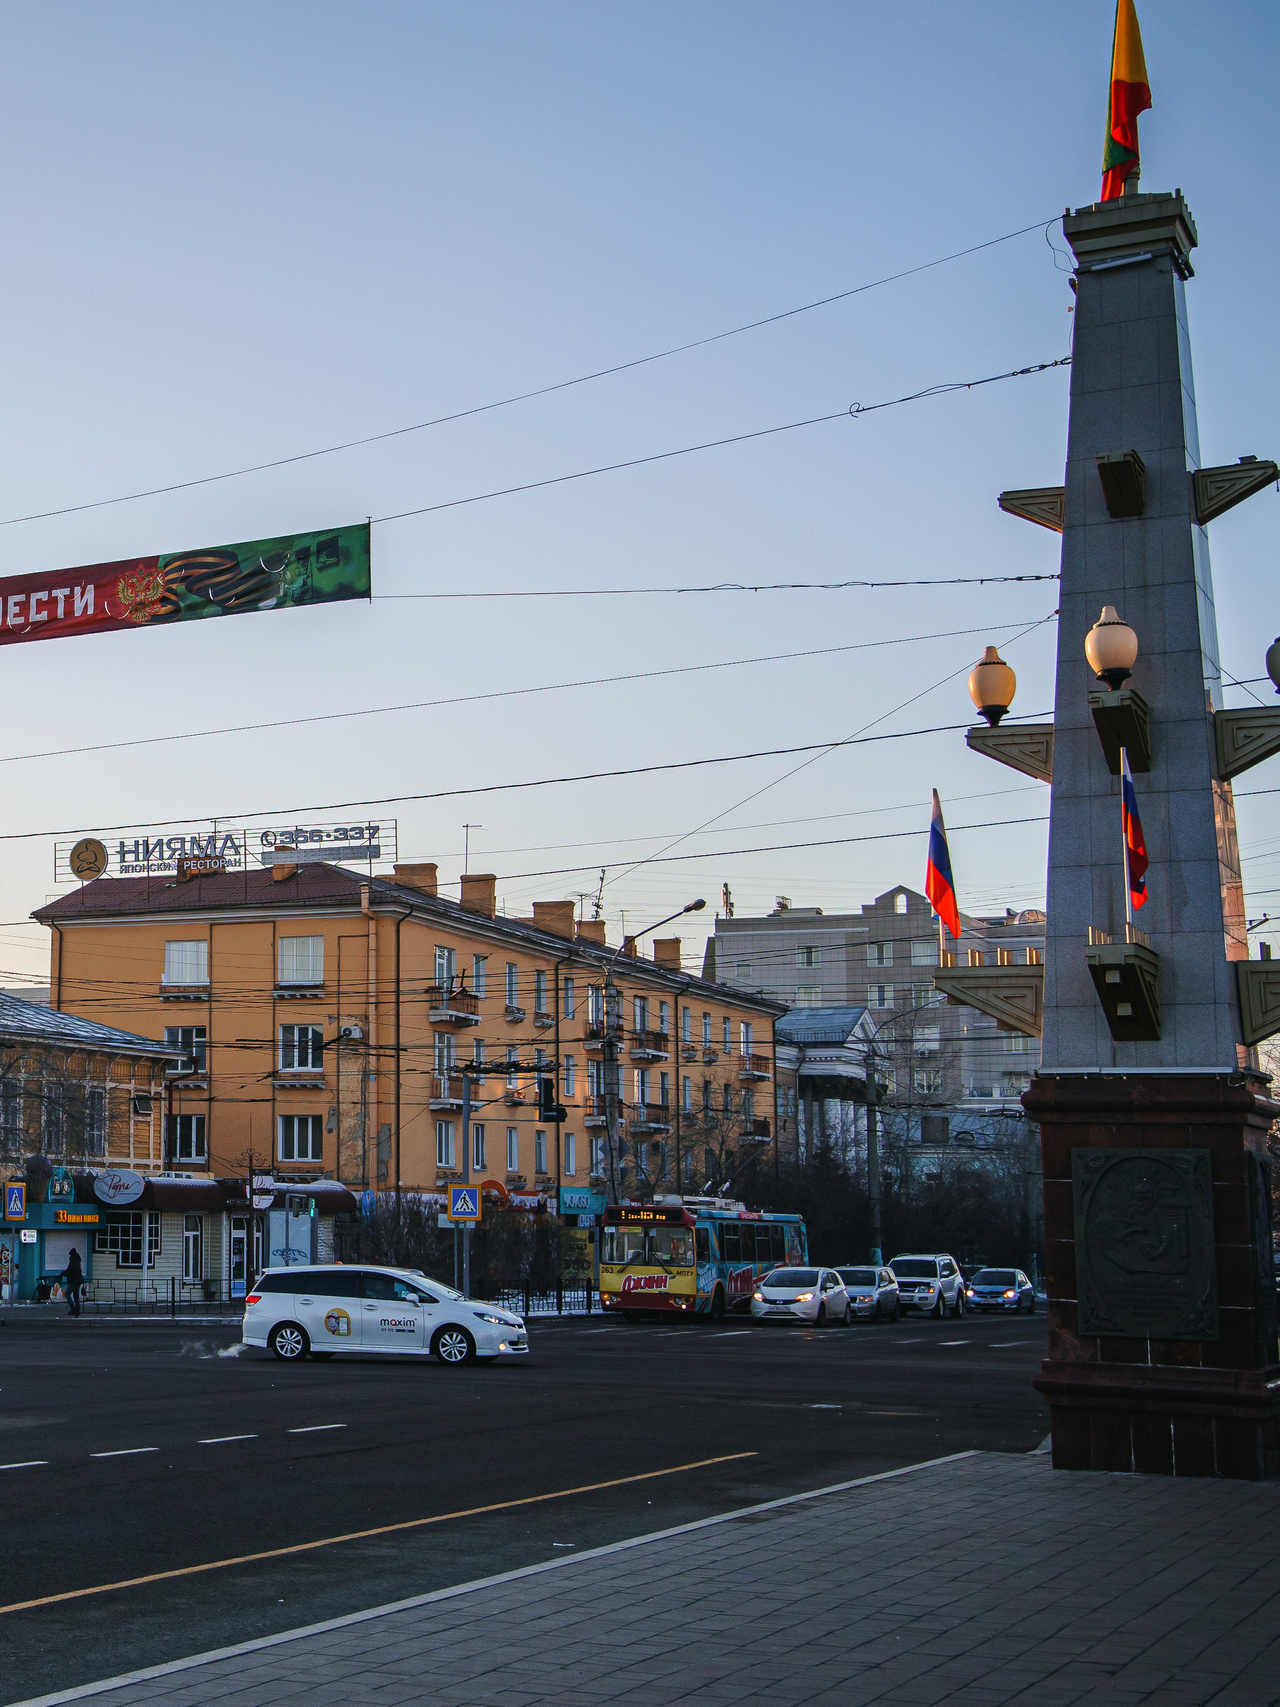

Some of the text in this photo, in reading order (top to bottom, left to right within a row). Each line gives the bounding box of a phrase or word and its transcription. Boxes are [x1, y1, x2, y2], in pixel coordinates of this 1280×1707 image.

[116, 834, 243, 863] НИЯМА
[119, 857, 242, 874] ЯПОНСКИЙ РЕСТОРАН
[380, 1317, 416, 1327] maxim
